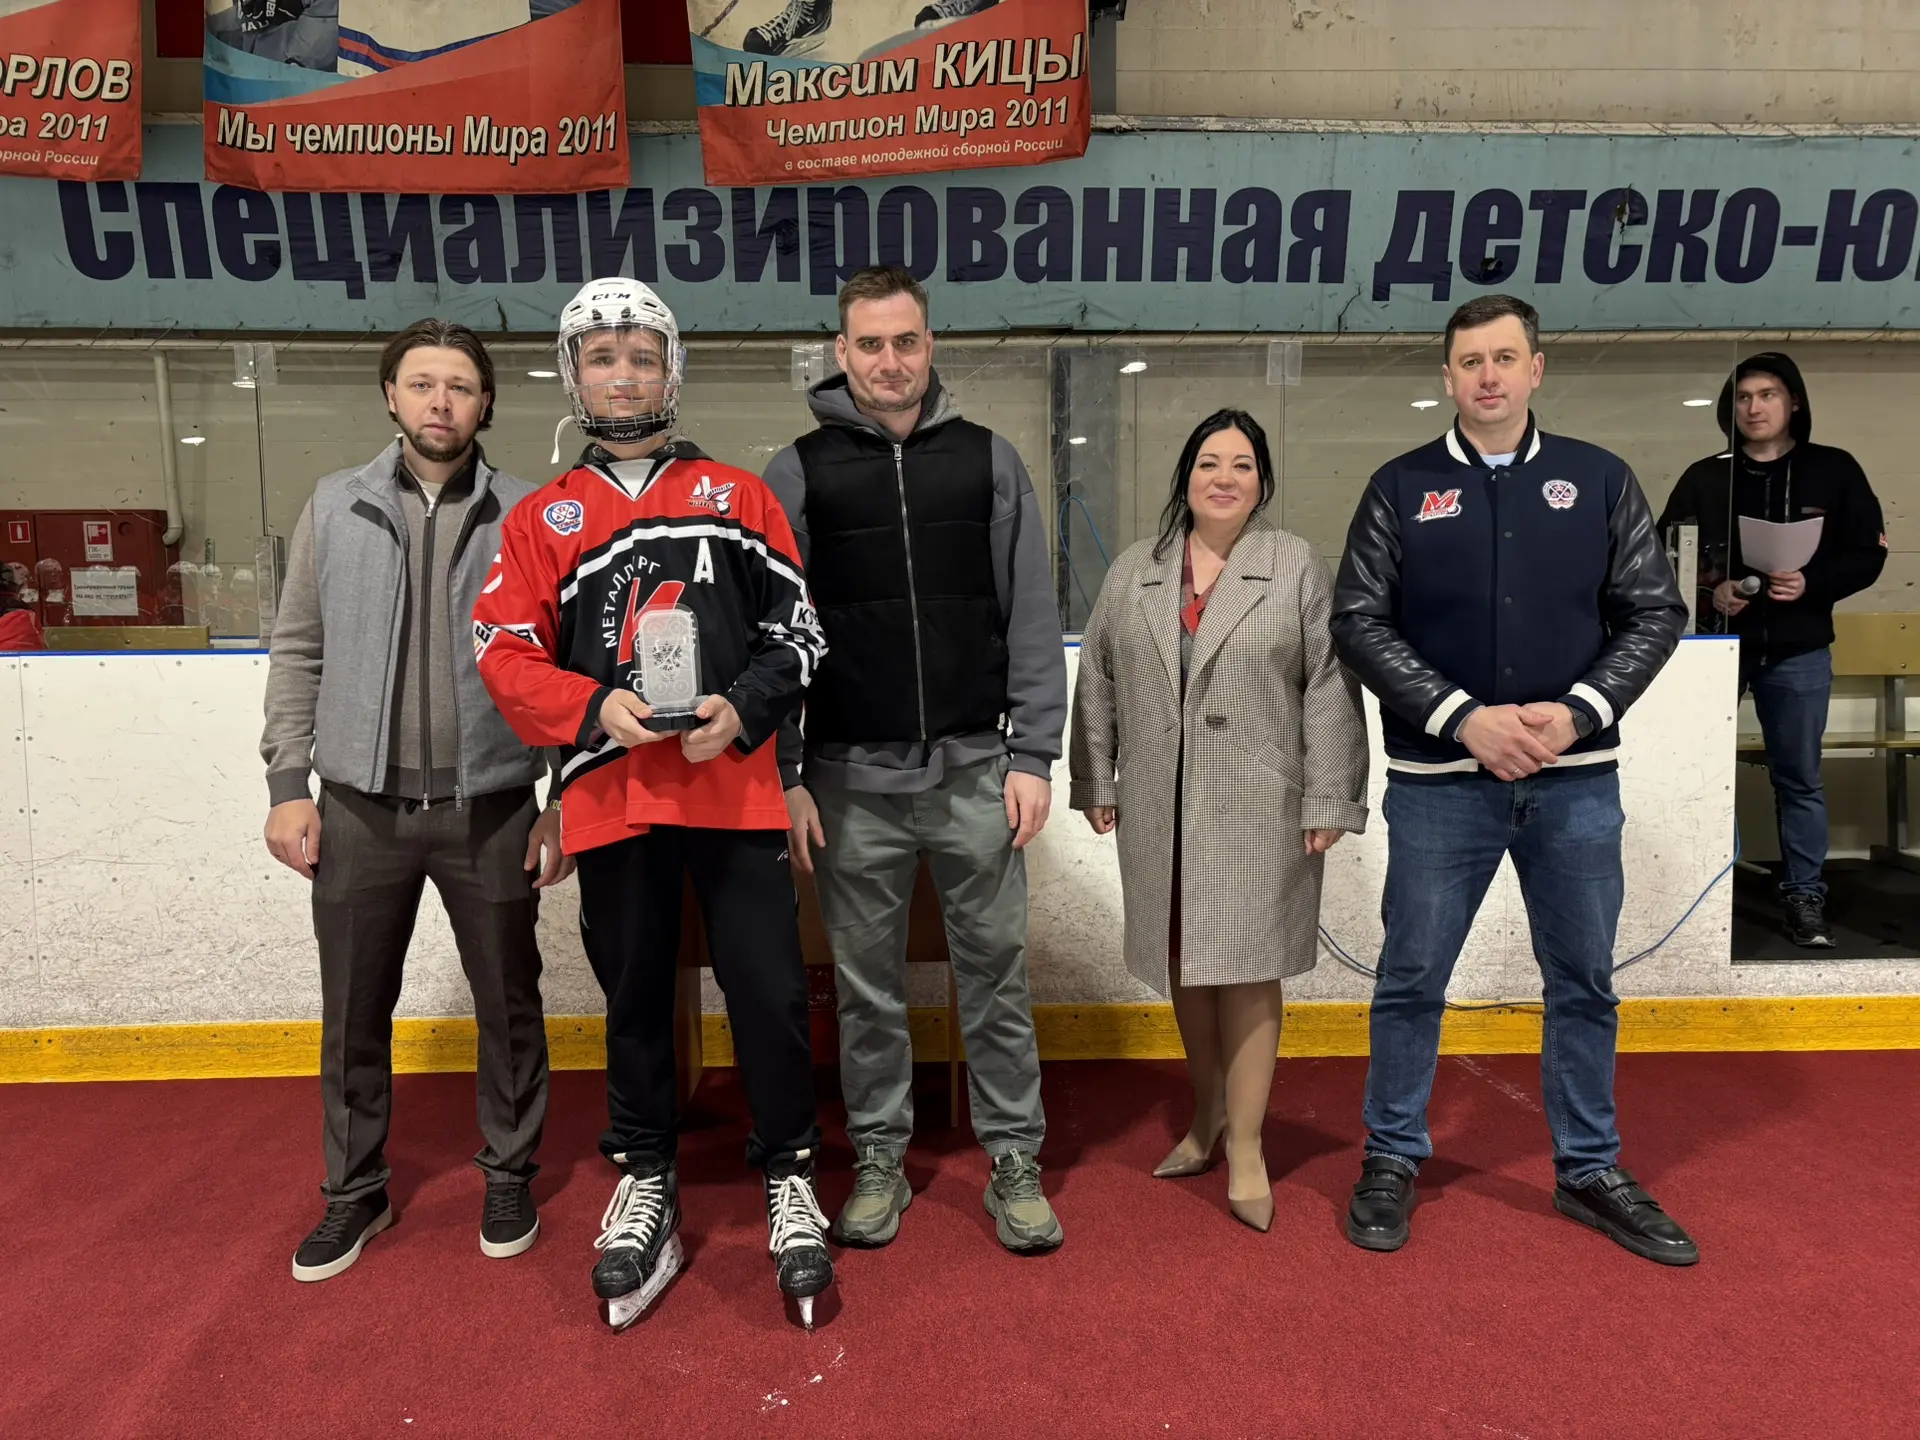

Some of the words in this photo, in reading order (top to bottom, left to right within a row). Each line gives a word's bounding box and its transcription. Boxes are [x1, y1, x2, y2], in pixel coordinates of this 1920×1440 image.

[0, 53, 133, 102] РЛОВ
[724, 58, 918, 108] Максим
[38, 112, 109, 142] 2011
[216, 107, 275, 153] Мы
[285, 121, 455, 156] чемпионы
[463, 115, 549, 165] Мира
[557, 111, 618, 155] 2011
[766, 112, 906, 147] Чемпион
[914, 103, 997, 138] Мира
[1004, 94, 1070, 128] 2011
[44, 150, 99, 165] России
[785, 160, 793, 171] в
[797, 154, 858, 170] составе
[860, 144, 949, 164] молодежной
[952, 140, 1012, 157] сборной
[1014, 137, 1064, 153] России
[57, 180, 1353, 300] Специализированная
[1372, 187, 1920, 302] детско-ю
[602, 555, 661, 649] МЕТАЛЛРГ
